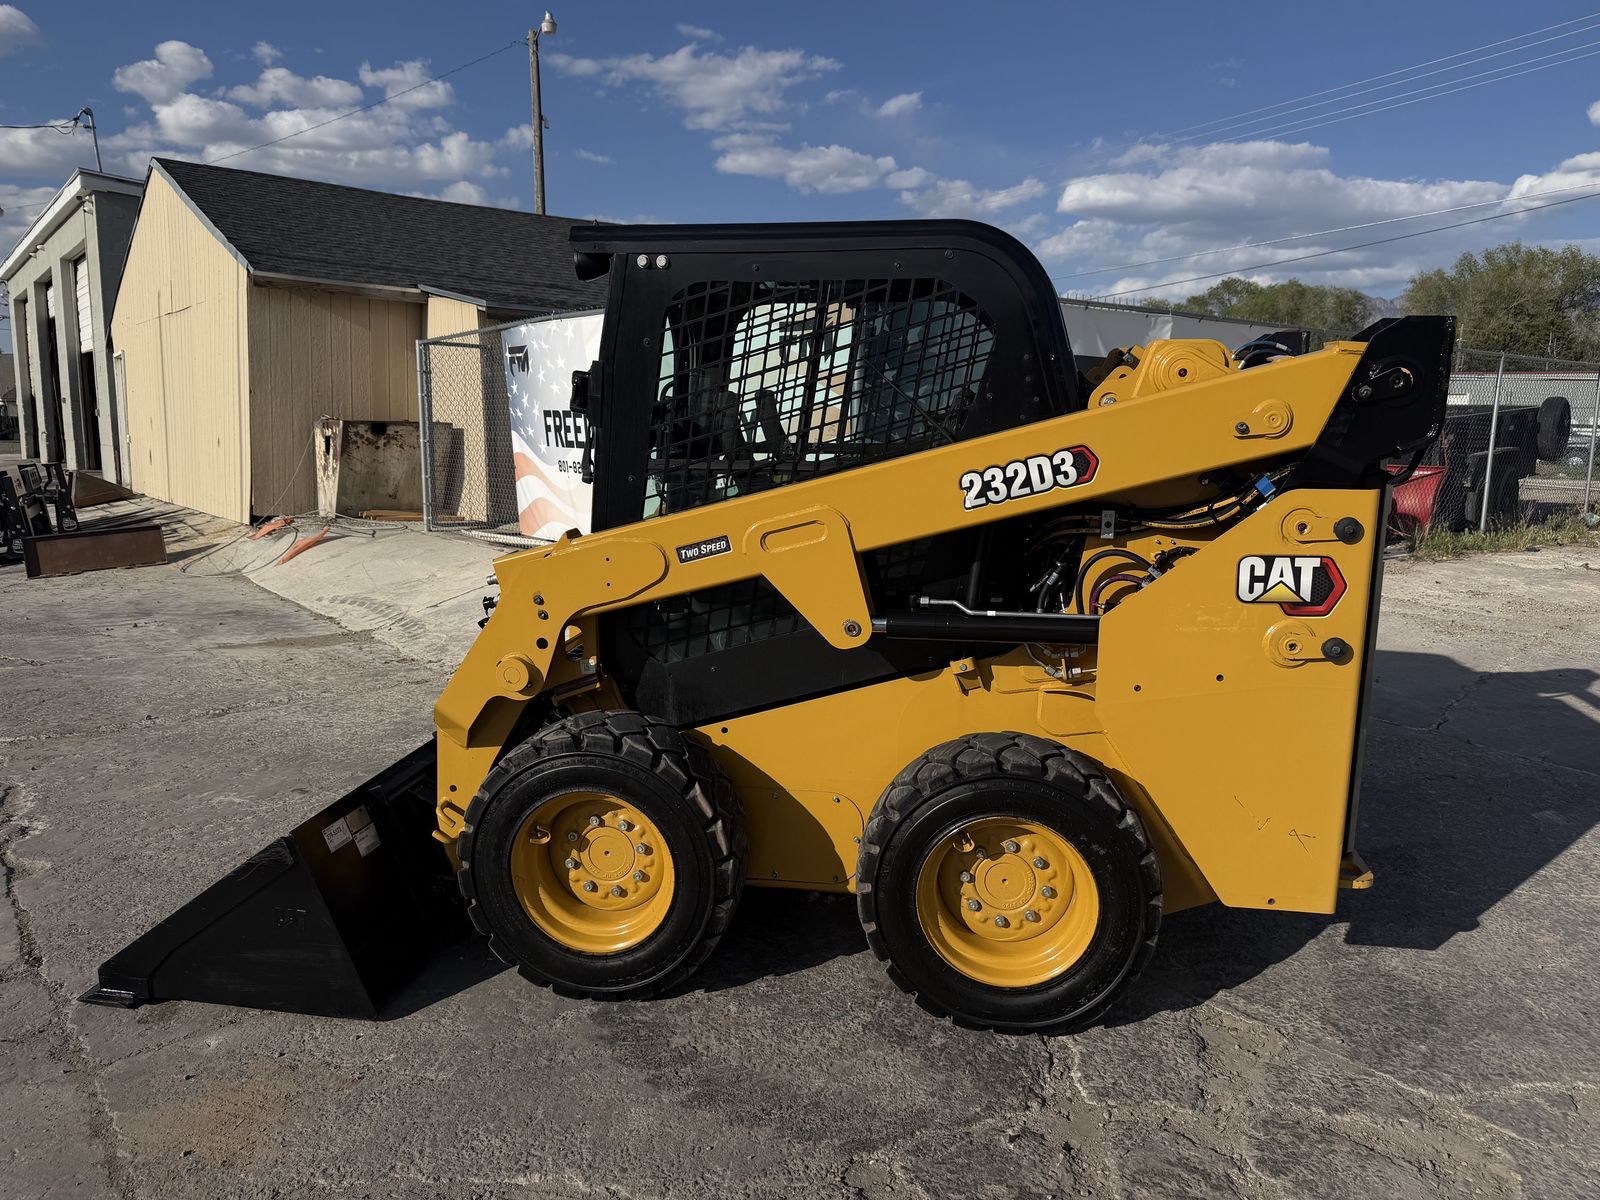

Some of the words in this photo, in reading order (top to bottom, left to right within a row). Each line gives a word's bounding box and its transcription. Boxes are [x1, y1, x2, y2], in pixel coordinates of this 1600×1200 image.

[558, 459, 583, 475] 801-82
[961, 450, 1078, 509] 232D3
[1238, 556, 1321, 603] CAT
